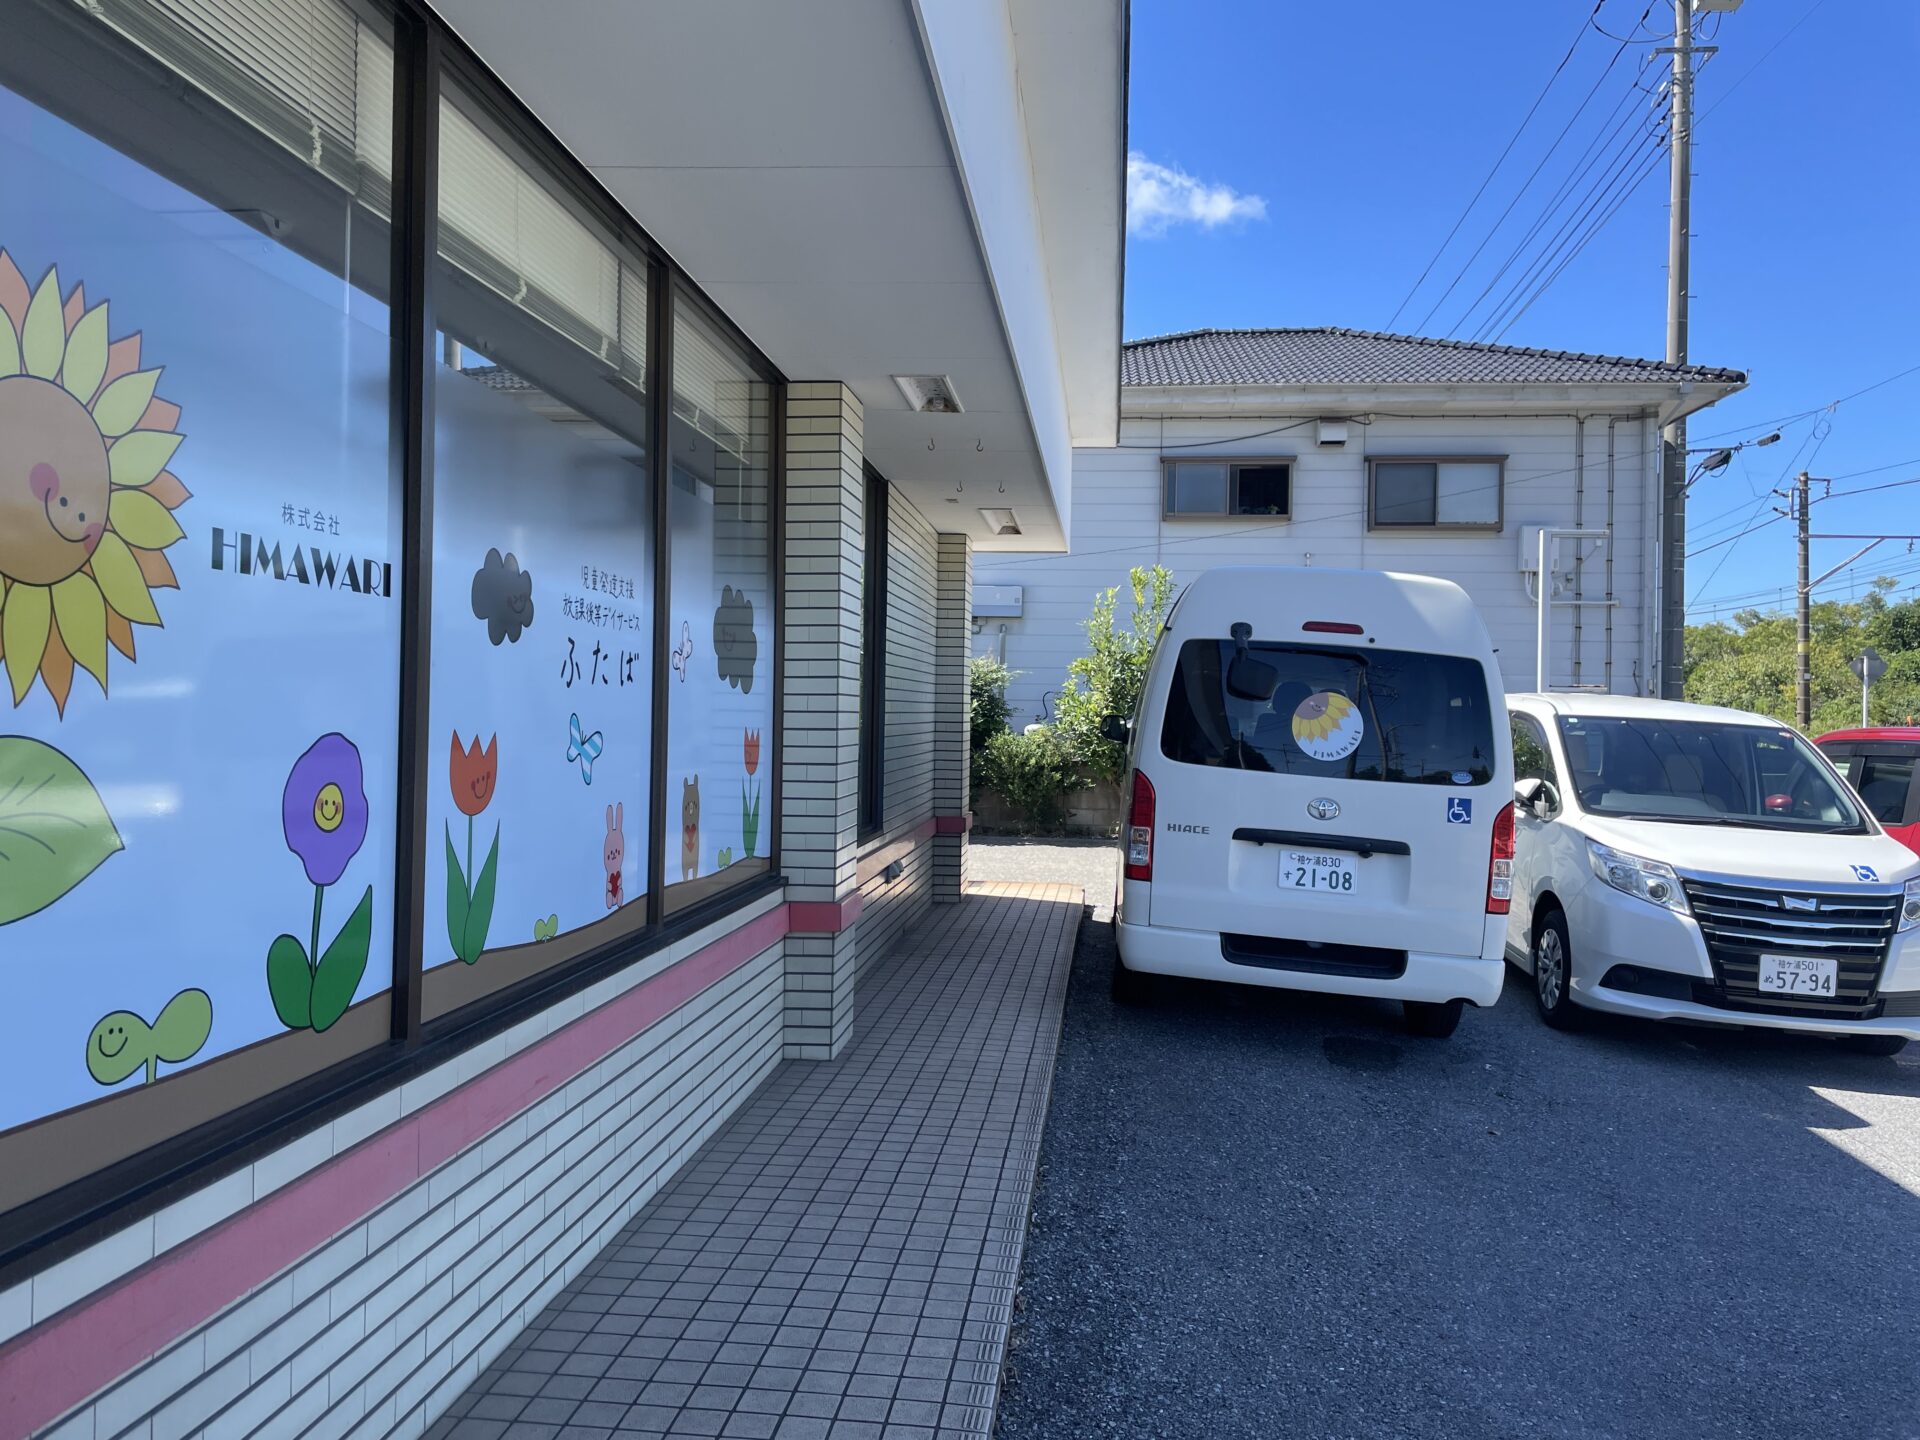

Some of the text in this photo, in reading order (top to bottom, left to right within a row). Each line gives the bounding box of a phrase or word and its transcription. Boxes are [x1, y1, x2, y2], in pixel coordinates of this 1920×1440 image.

[282, 502, 340, 536] 株式会社
[211, 527, 392, 598] HIMAWARI
[581, 565, 635, 600] 児童発達支援
[562, 592, 640, 632] 放課後等デイサービス
[561, 637, 639, 689] ふたば
[1167, 823, 1210, 835] HIACE
[1295, 867, 1352, 891] 21-08
[1776, 970, 1831, 993] 57-94
